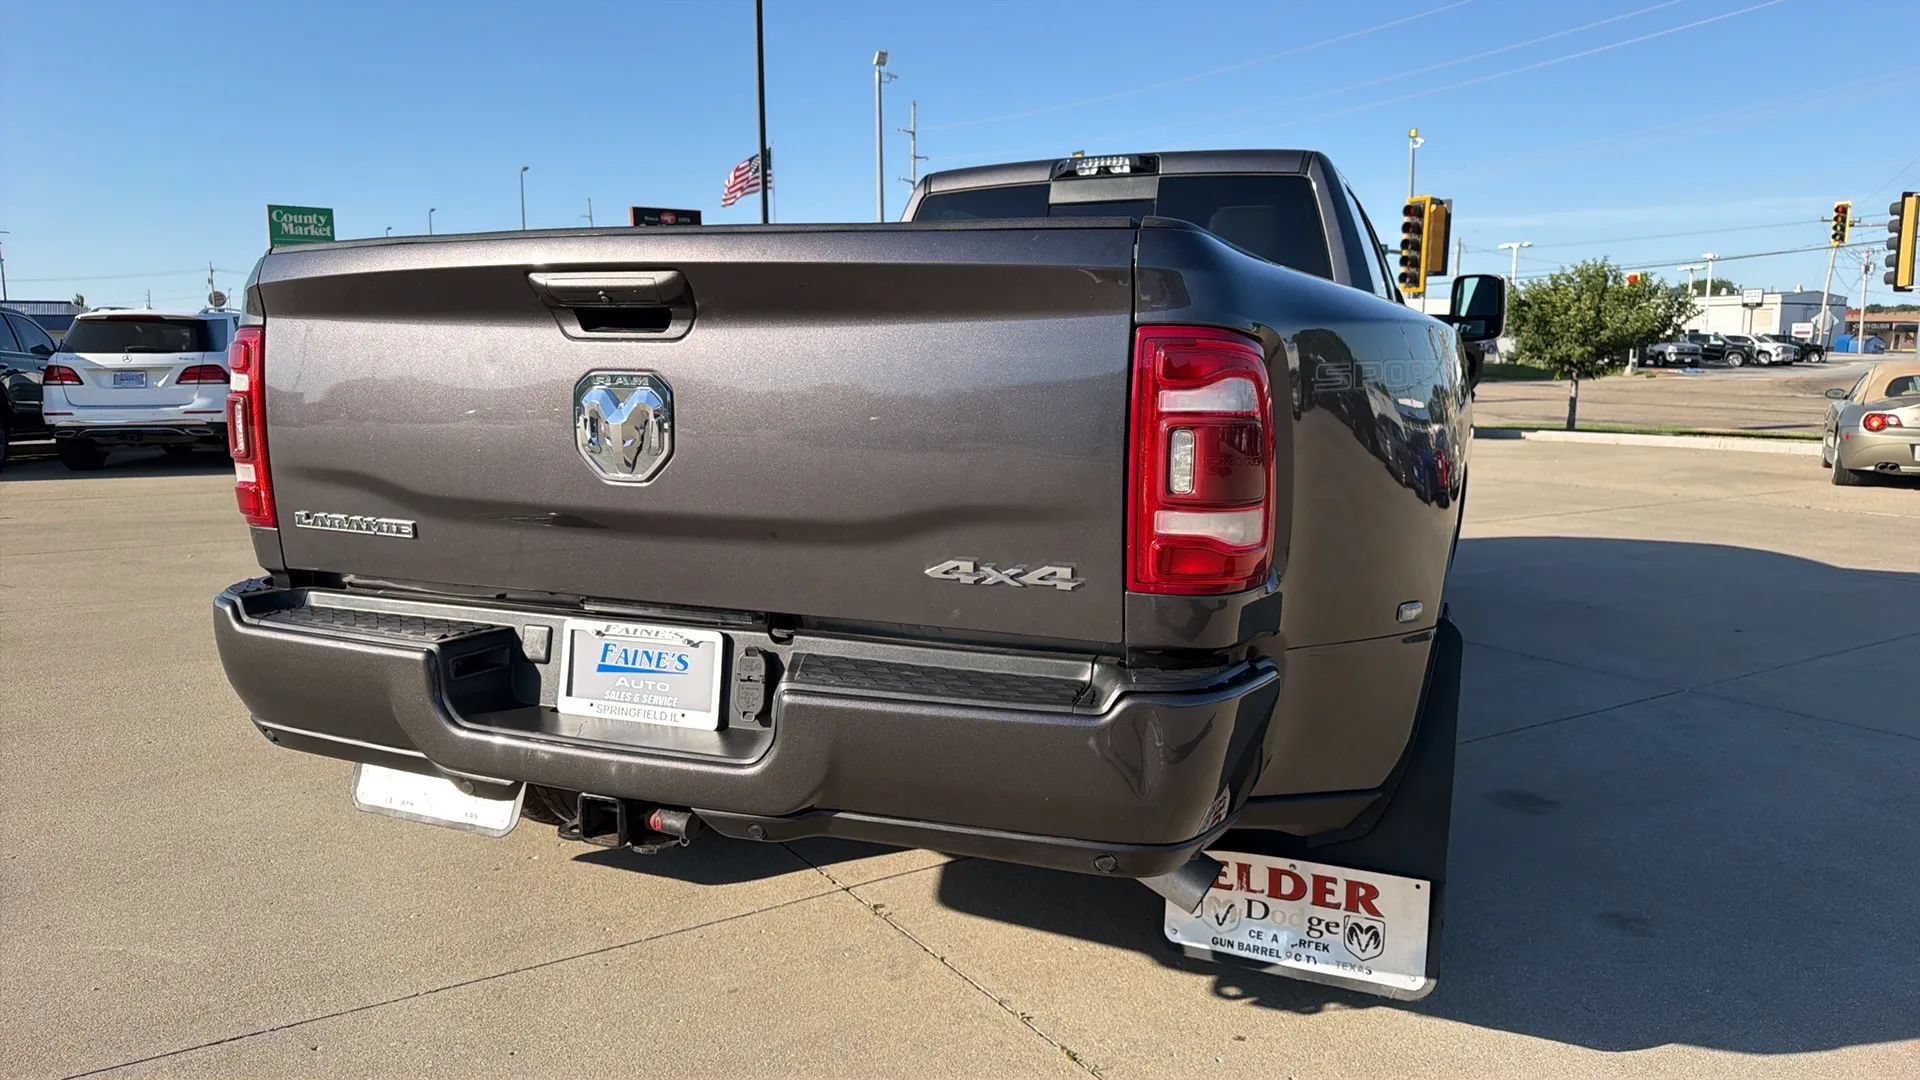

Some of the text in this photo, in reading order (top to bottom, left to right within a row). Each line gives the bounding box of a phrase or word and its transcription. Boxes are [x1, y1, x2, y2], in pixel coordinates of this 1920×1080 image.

[271, 209, 327, 226] County
[281, 223, 332, 236] Market
[594, 376, 649, 386] RAM
[1314, 360, 1434, 391] SPOR
[295, 511, 416, 538] LARAMIE
[605, 624, 685, 639] FAINE'S
[600, 643, 689, 671] FAINE'S
[615, 676, 670, 692] AUTO
[604, 690, 679, 707] SALES & SERVICE
[596, 704, 680, 723] SPRINGFIELD IL
[1211, 936, 1235, 949] GUN
[1237, 941, 1282, 959] BARREL
[1335, 960, 1373, 976] TEXAS
